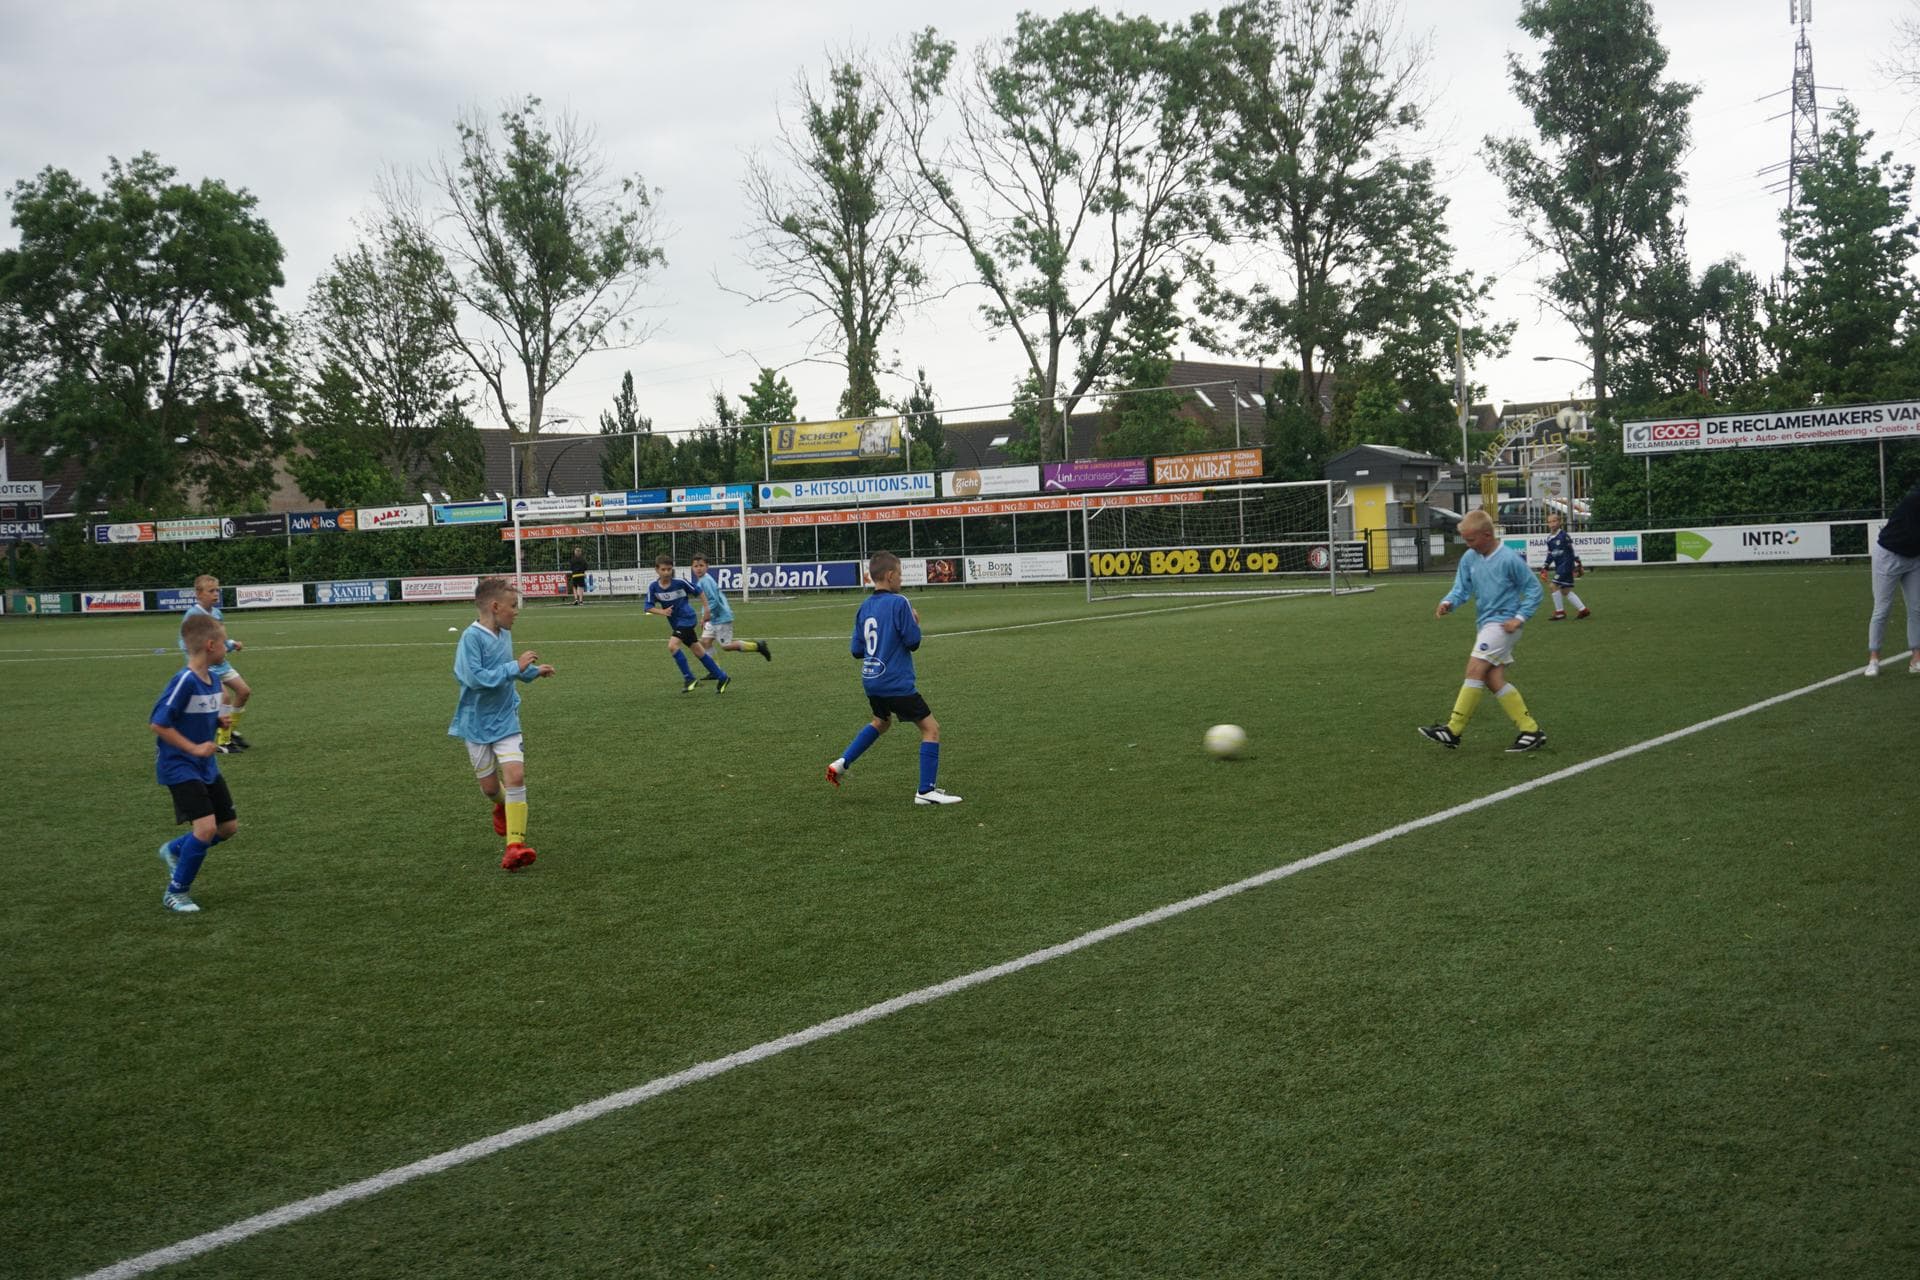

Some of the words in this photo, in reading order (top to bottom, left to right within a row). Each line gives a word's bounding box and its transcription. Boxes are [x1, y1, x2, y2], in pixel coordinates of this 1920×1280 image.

[1707, 421, 1729, 434] DE
[1733, 409, 1883, 433] RECLAMEMAKERS
[799, 431, 848, 441] SCHERP
[1654, 425, 1699, 439] GOOS
[1707, 435, 1747, 445] Drukwerk
[1756, 433, 1779, 442] Auto-
[1781, 432, 1792, 440] en
[1875, 423, 1908, 433] Creatie
[1627, 439, 1700, 449] RECLAMEMAKERS
[1156, 463, 1190, 482] BELLO
[1192, 460, 1232, 480] MURAT
[795, 476, 932, 497] B-KITSOLUTIONS.NL
[955, 477, 978, 494] Zicht
[373, 509, 400, 524] AJAX
[706, 519, 720, 528] ING
[761, 517, 775, 525] ING
[789, 515, 804, 524] ING
[818, 513, 832, 522] ING
[876, 511, 890, 519] ING
[906, 509, 921, 518] ING
[936, 507, 952, 515] ING
[967, 505, 983, 514] ING
[1001, 503, 1017, 512] ING
[1033, 501, 1050, 510] ING
[1066, 499, 1082, 508] ING
[1135, 495, 1152, 504] ING
[1169, 493, 1187, 502] ING
[1743, 529, 1799, 546] INTRO
[1616, 544, 1638, 553] HAANS
[1089, 551, 1144, 576] 100%
[1150, 549, 1201, 574] BOB
[1209, 548, 1241, 573] 0%
[1246, 552, 1279, 575] op
[717, 564, 829, 589] Rabobank
[333, 585, 371, 598] XANTHI
[864, 616, 878, 656] 6
